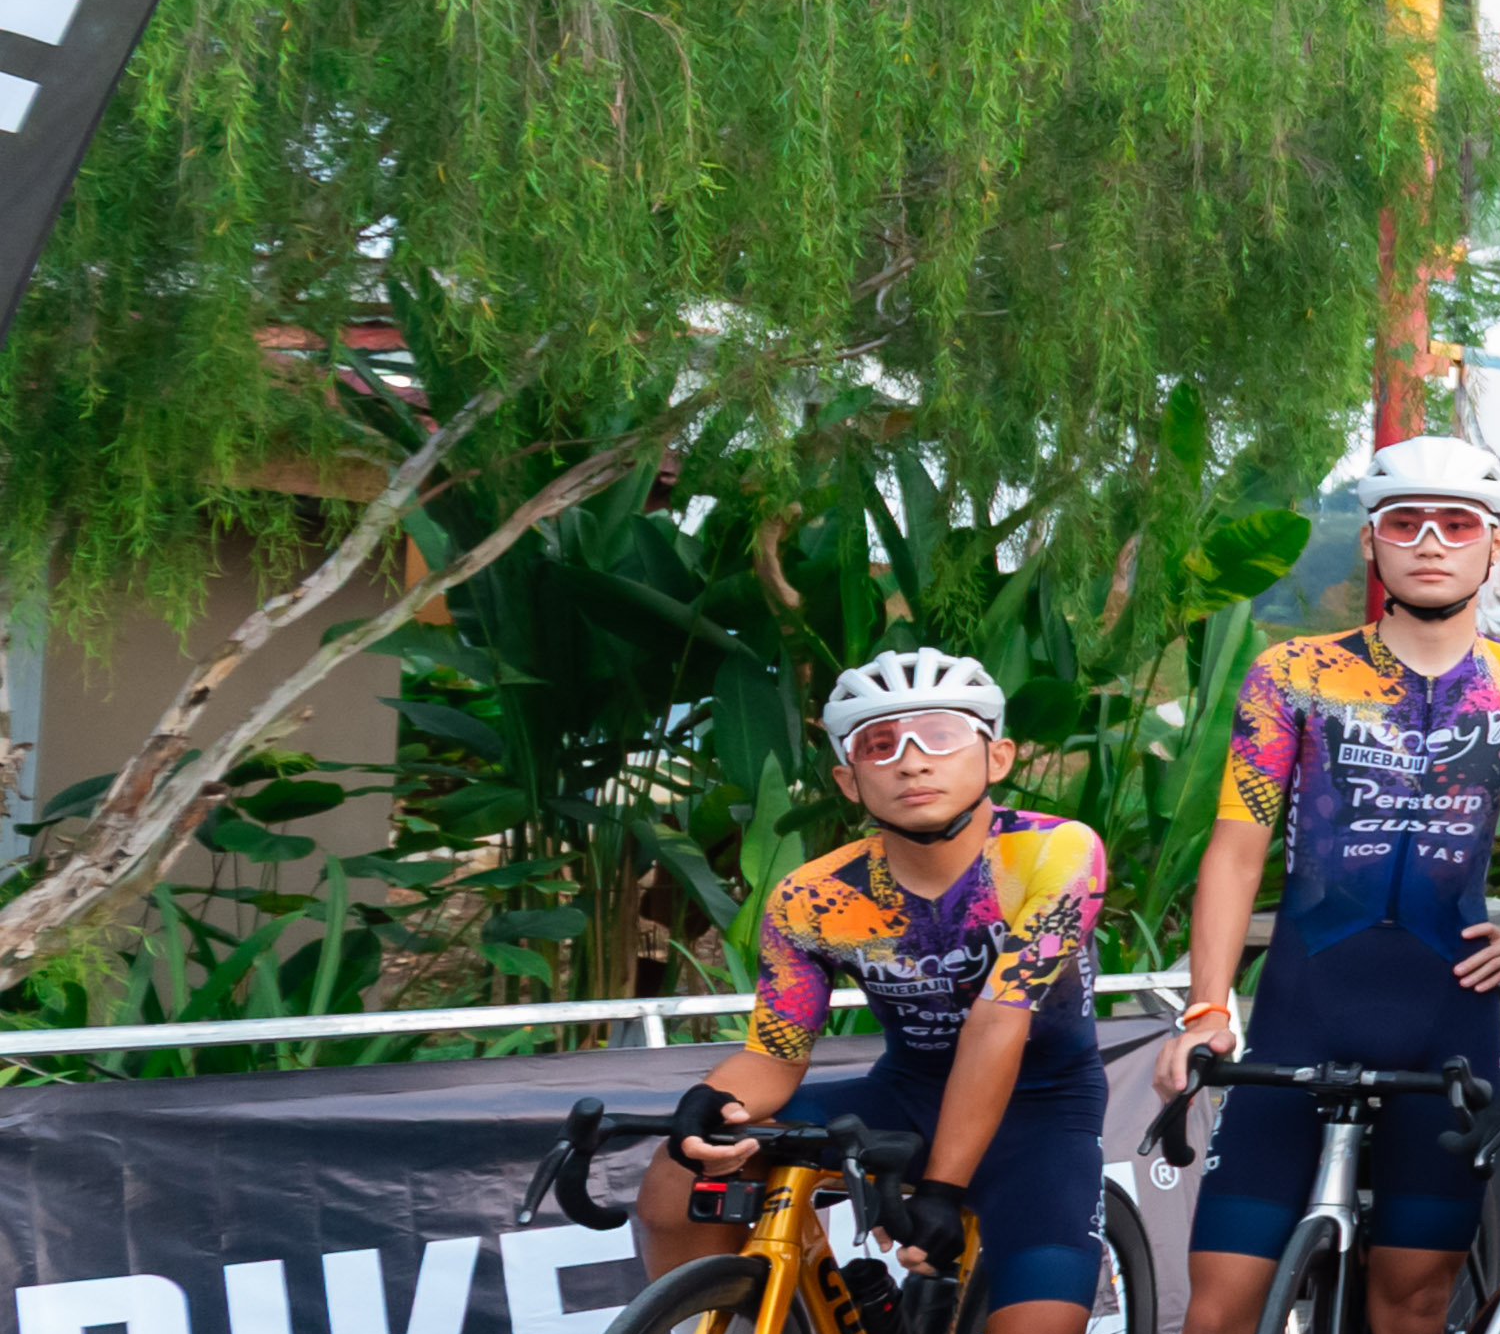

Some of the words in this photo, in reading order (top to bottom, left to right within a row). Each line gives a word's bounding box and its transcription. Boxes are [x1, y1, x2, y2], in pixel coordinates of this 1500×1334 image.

[1340, 746, 1425, 771] BIKEBAJU
[1347, 777, 1482, 814] Perstorp
[1350, 819, 1475, 836] GUSTO
